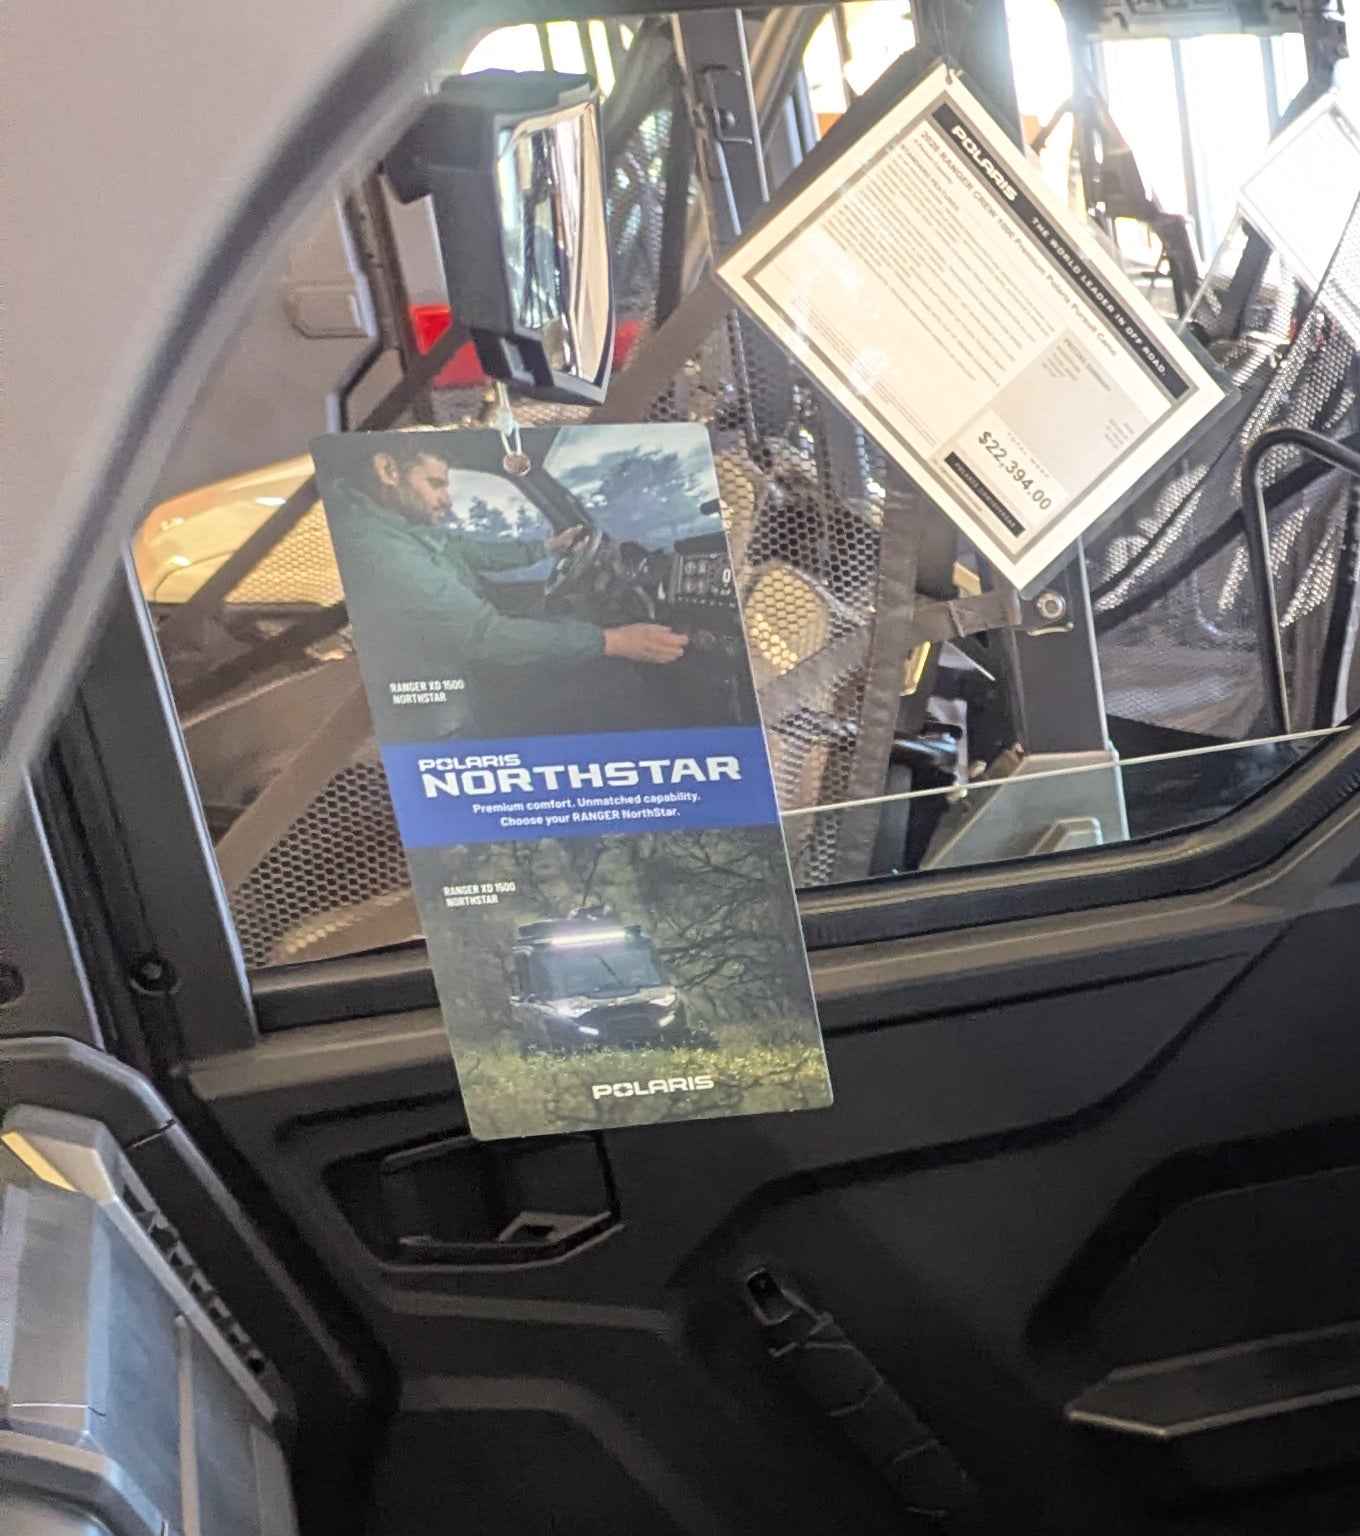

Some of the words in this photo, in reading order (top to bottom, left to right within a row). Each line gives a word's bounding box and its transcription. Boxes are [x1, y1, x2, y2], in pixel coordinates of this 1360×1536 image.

[937, 151, 974, 191] RANGER
[971, 189, 998, 219] CREW
[1012, 237, 1048, 276] Premium
[1044, 273, 1072, 304] Polaris
[1069, 302, 1098, 334] Pursuit
[949, 122, 1020, 203] POLARIS
[1030, 216, 1050, 239] THE
[1048, 237, 1082, 275] WORLD
[1079, 273, 1115, 314] LEADER
[1112, 312, 1126, 327] IN
[1123, 325, 1143, 346] OFF
[974, 428, 1054, 513] $22,394.00
[390, 681, 427, 693] RANGER
[428, 680, 441, 691] XD
[443, 679, 465, 690] 1500
[392, 692, 447, 704] NORTHSTAR
[418, 754, 521, 772] POLARIS
[421, 755, 742, 798] NORTHSTAR
[472, 802, 524, 814] Premium
[526, 799, 575, 811] comfort.
[577, 794, 641, 808] Unmatched
[643, 791, 701, 805] capability.
[500, 815, 543, 827] Choose
[545, 813, 570, 825] your
[572, 809, 620, 823] RANGER
[621, 807, 680, 820] NorthStar.
[443, 884, 479, 896] RANGER
[481, 883, 493, 894] XD
[495, 881, 516, 893] 1500
[446, 894, 499, 907] NORTHSTAR
[592, 1075, 714, 1100] POLARIS
